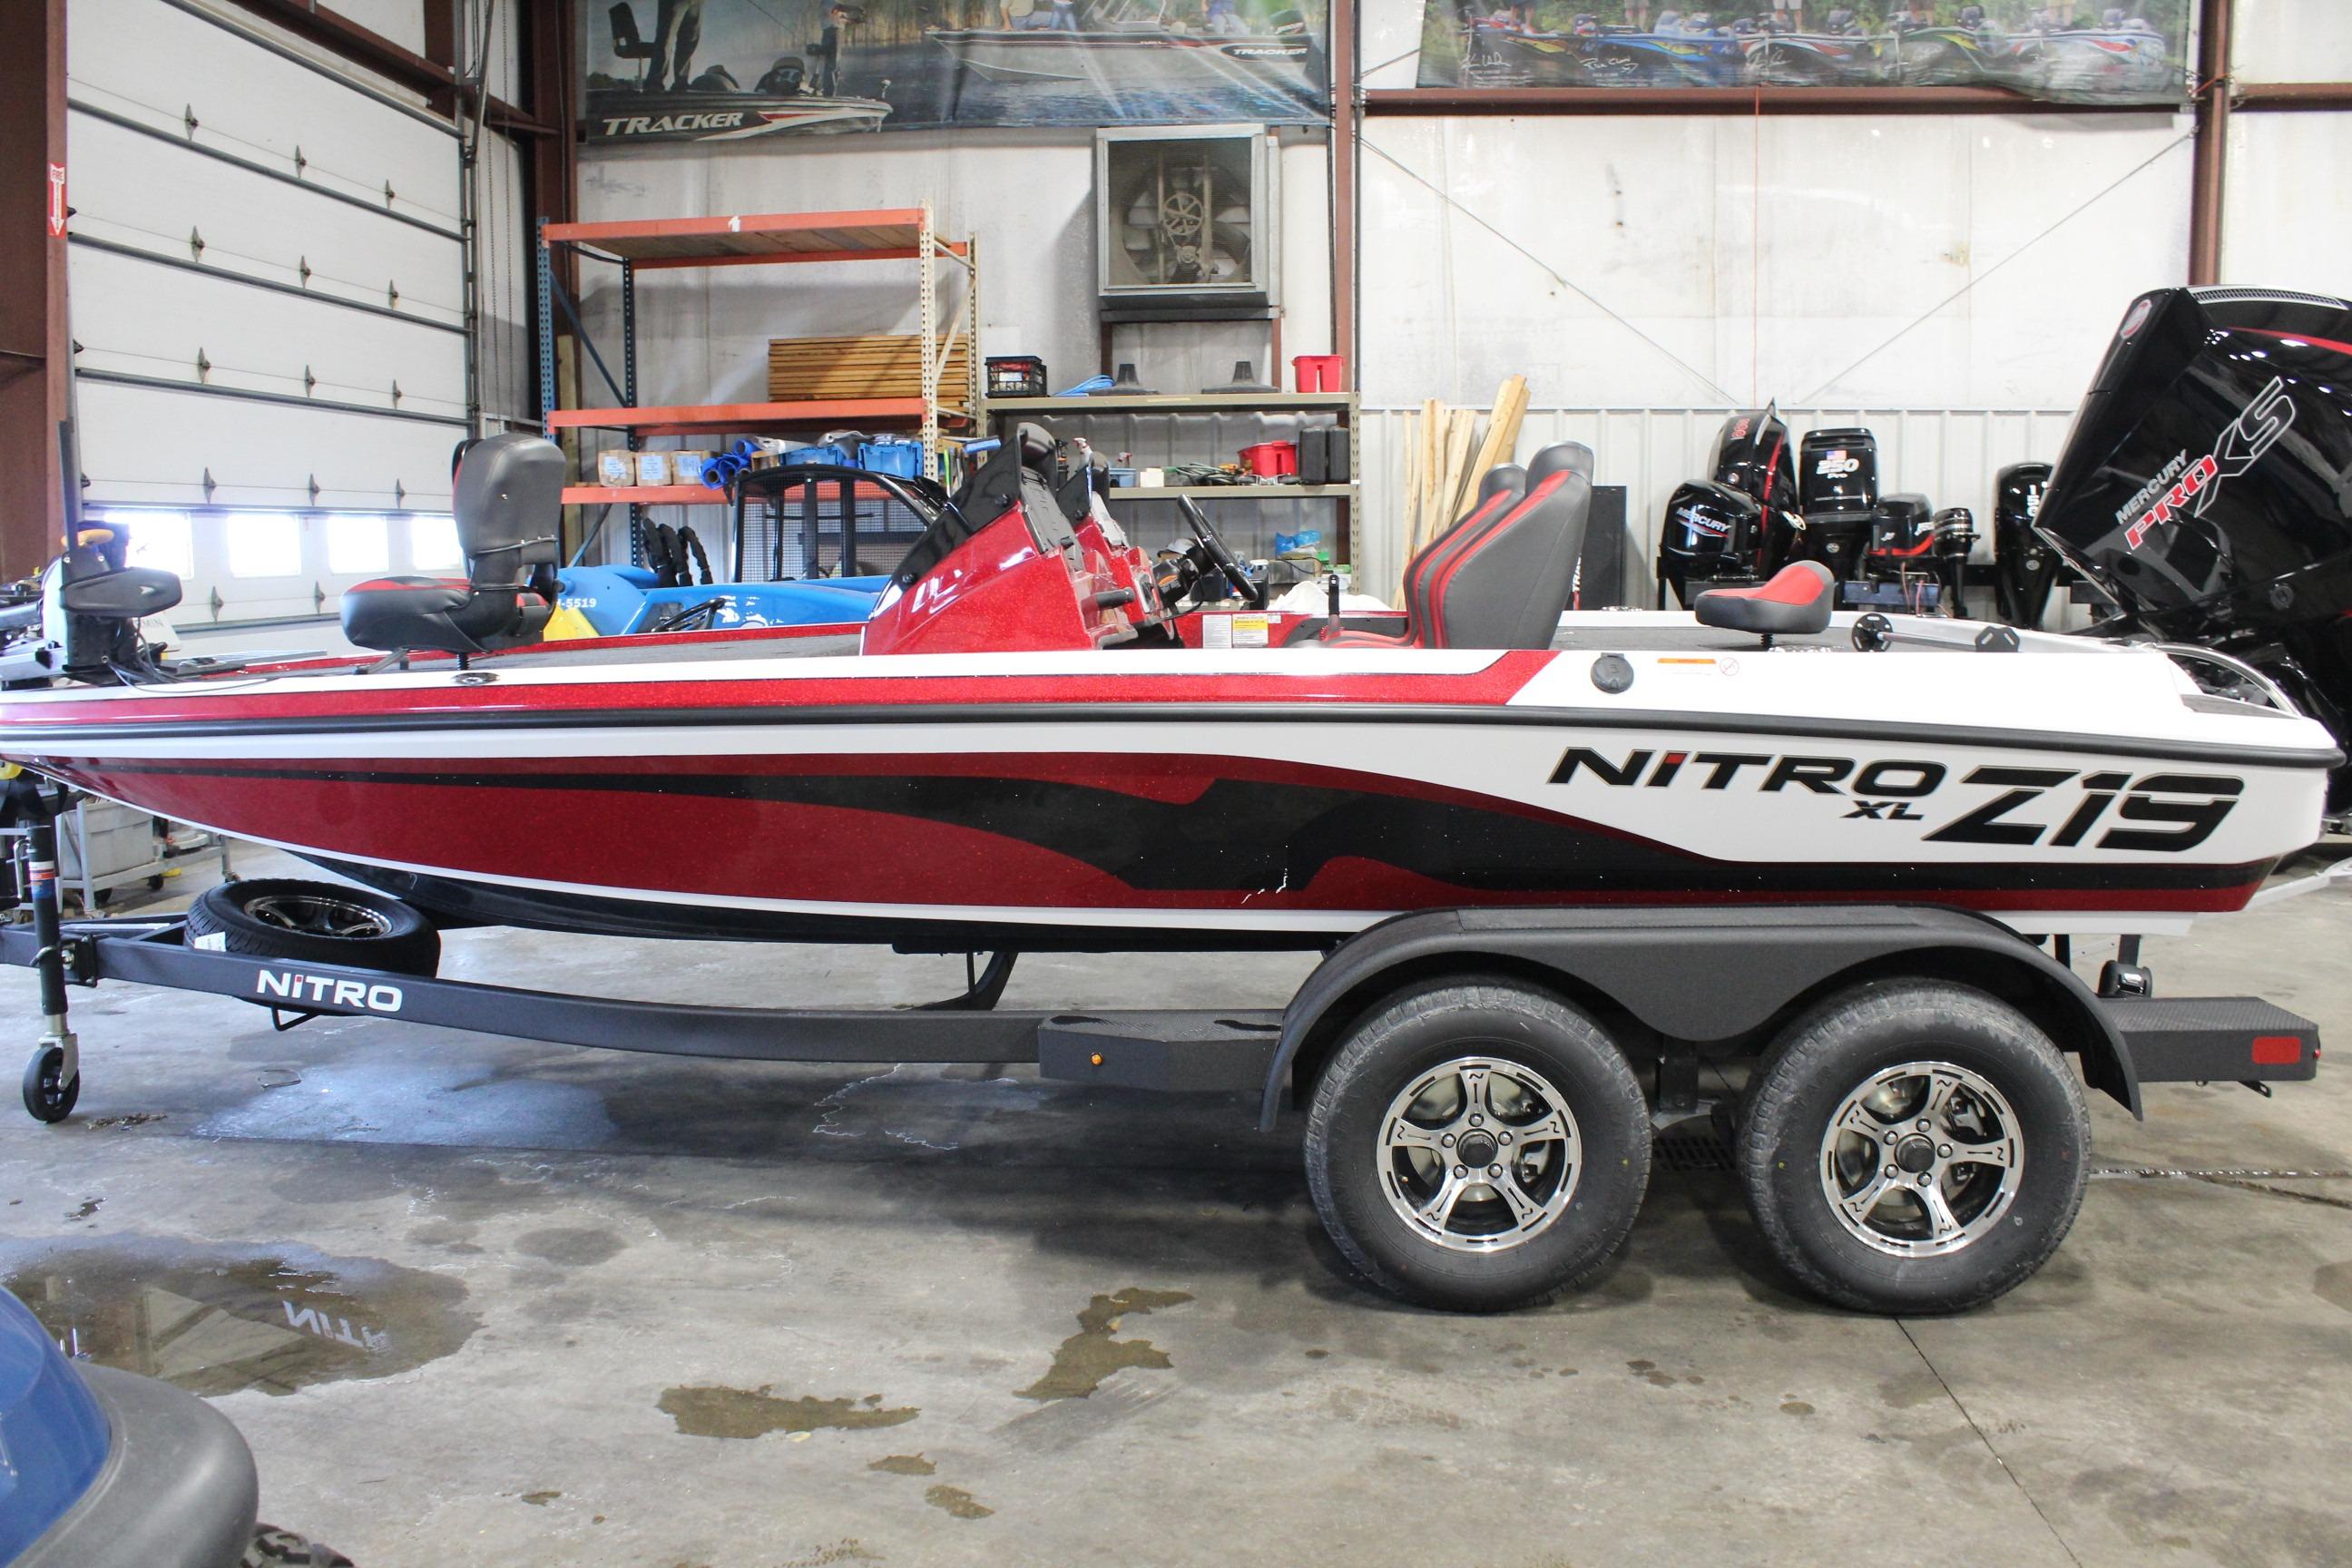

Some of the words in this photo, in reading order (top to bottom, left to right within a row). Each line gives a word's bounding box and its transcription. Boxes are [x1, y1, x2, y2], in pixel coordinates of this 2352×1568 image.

[603, 112, 744, 136] TRACKER
[1817, 458, 1859, 475] 250
[2114, 448, 2187, 525] MERCURY
[2123, 454, 2219, 551] PRO
[1676, 506, 1733, 532] MERCURY
[1545, 746, 1948, 797] NITRO
[1920, 764, 2245, 852] Z19
[1839, 799, 1926, 820] XL
[256, 969, 403, 1013] NITRO
